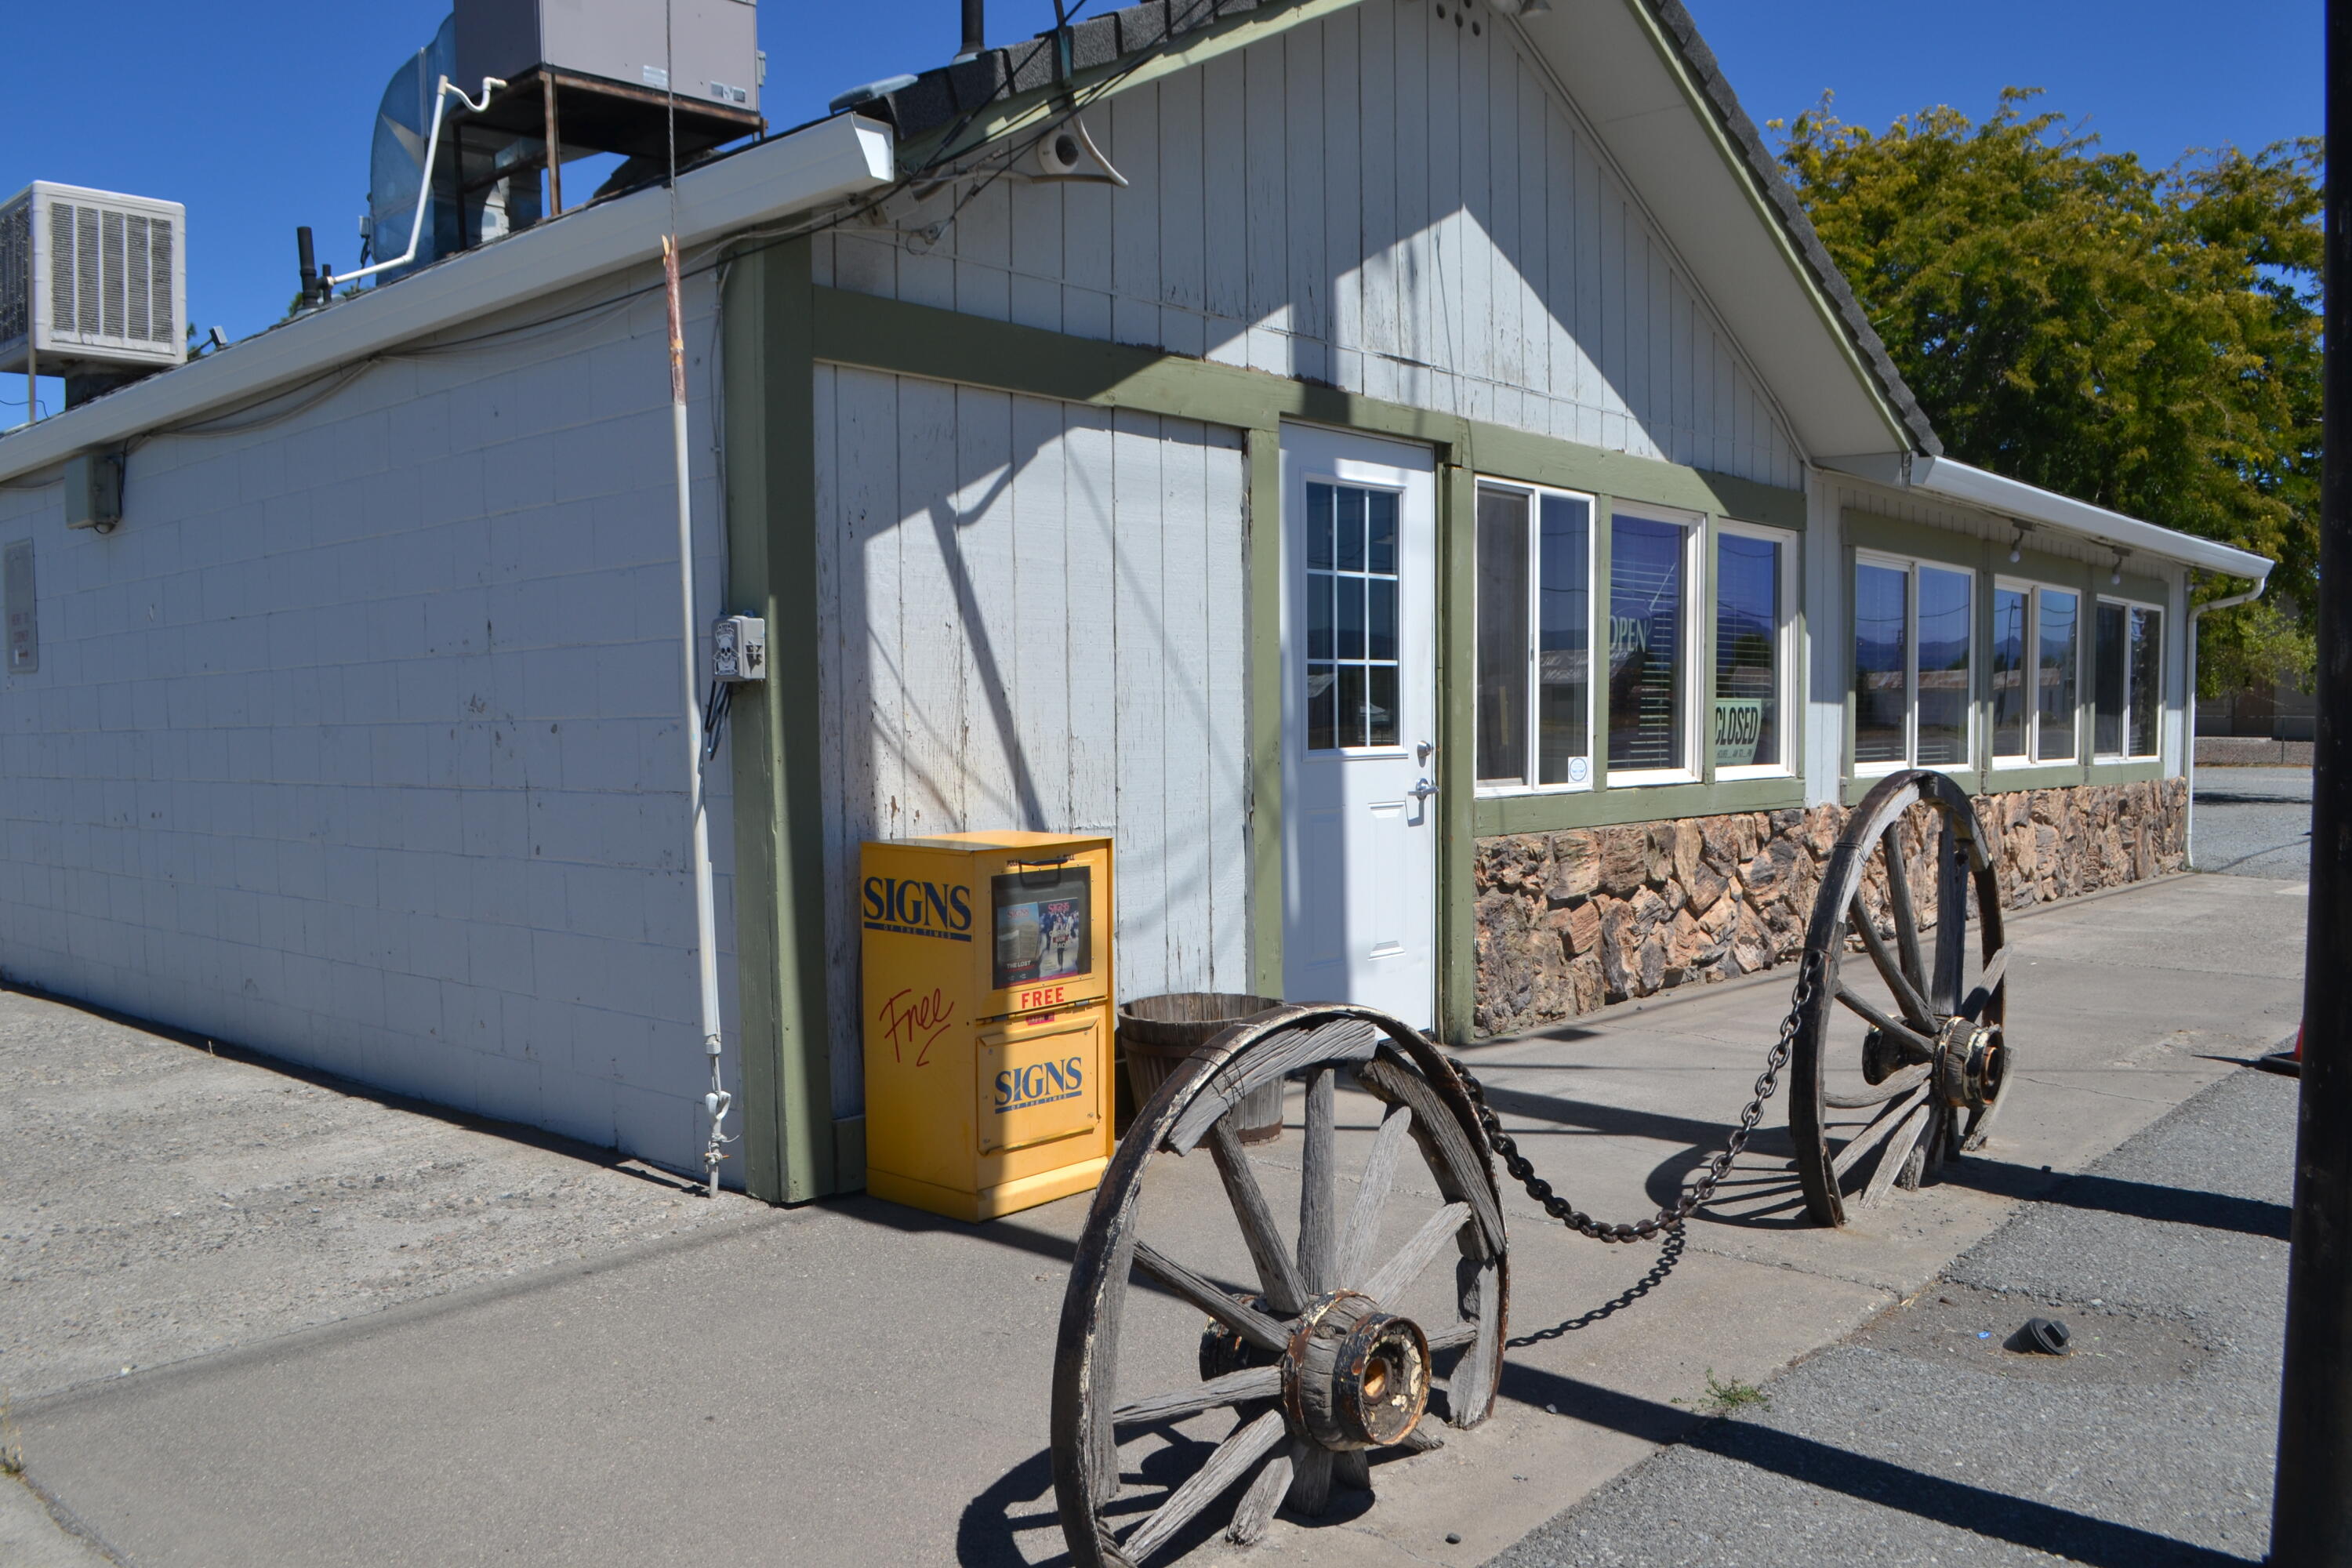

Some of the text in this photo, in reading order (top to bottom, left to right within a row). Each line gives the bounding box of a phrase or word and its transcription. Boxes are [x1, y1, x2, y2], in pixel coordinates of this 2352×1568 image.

[1715, 706, 1759, 746] CLOSED
[863, 876, 972, 931] SIGNS
[1022, 986, 1065, 1010] FREE
[879, 987, 955, 1063] Free
[994, 1056, 1082, 1106] SIGNS
